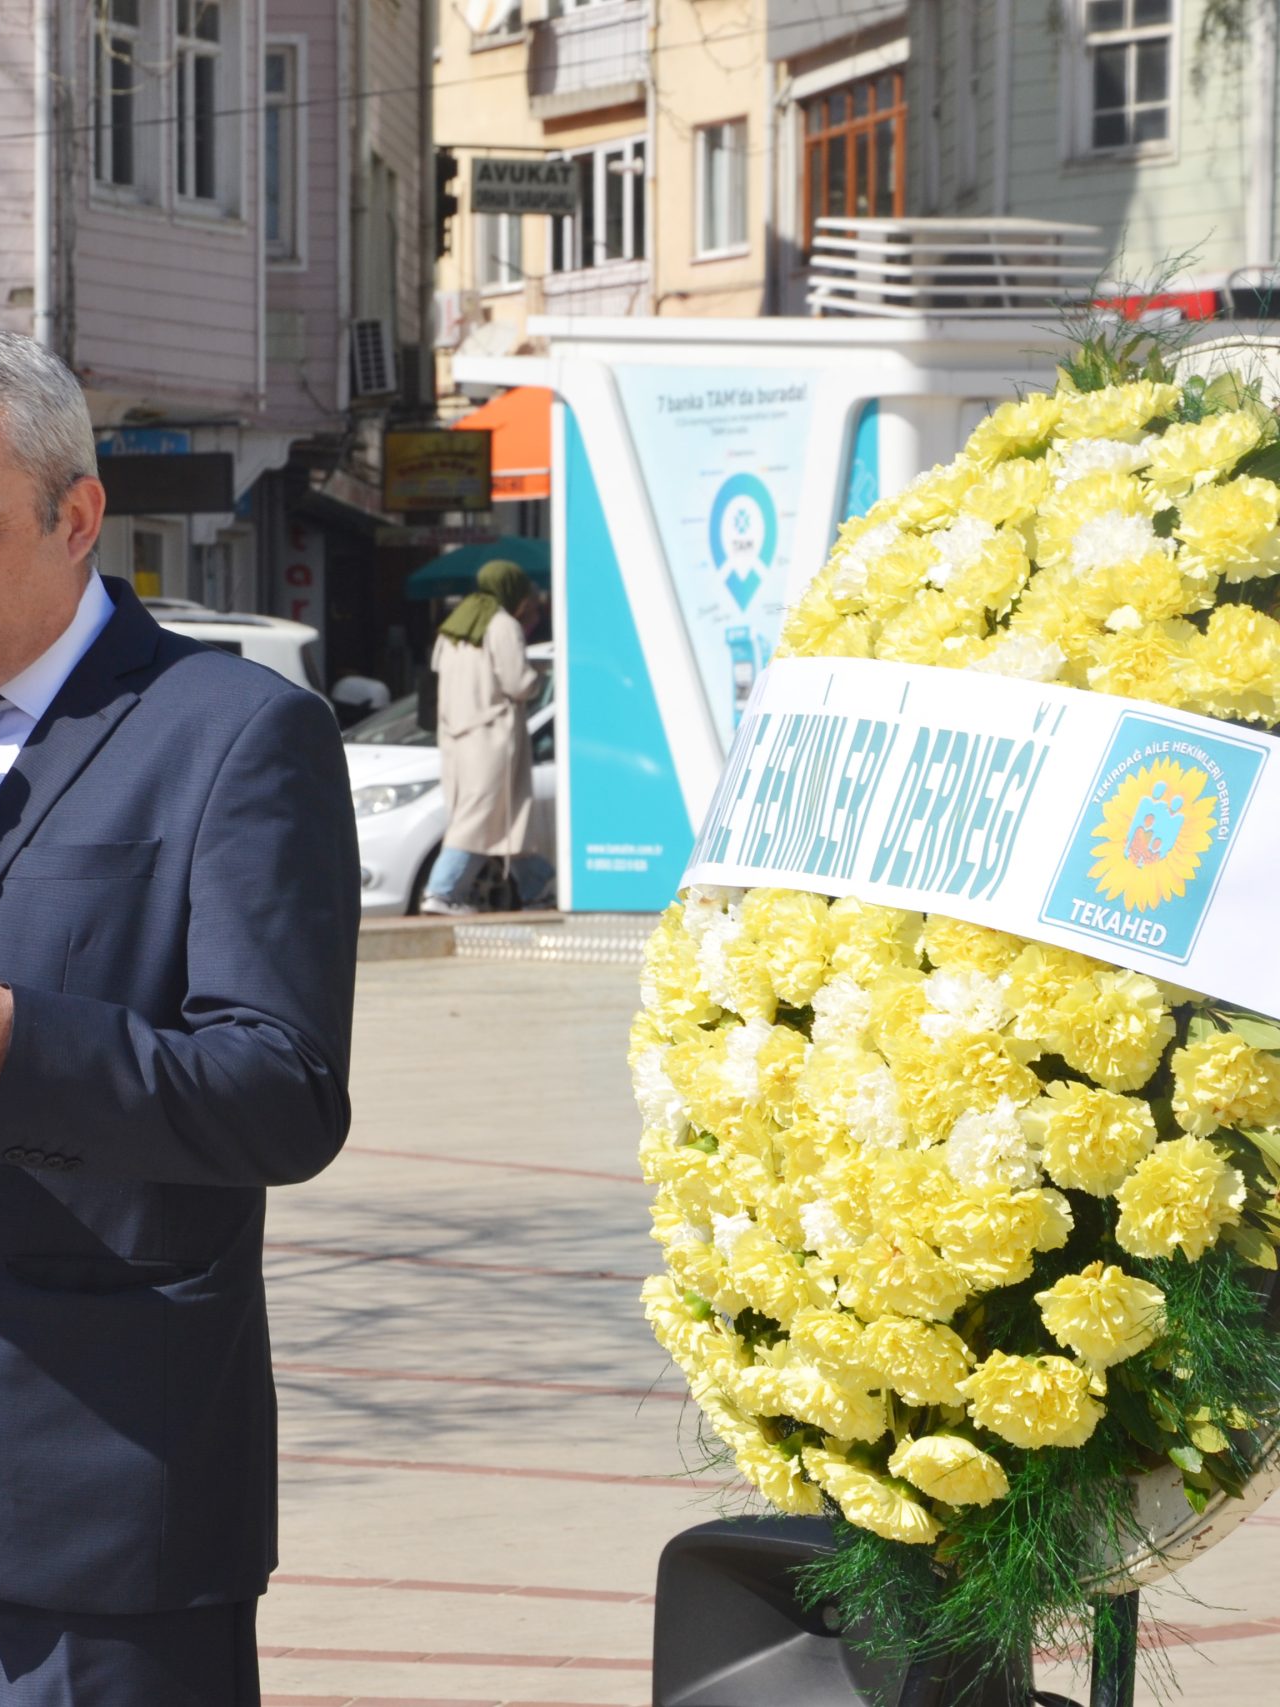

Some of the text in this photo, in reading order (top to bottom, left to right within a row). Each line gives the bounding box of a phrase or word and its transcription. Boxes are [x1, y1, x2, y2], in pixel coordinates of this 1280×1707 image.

[478, 164, 573, 184] AVUKAT
[869, 701, 1068, 902] DERNEĞİ
[1092, 740, 1231, 841] TEKİRDAĞ AİLE HEKİMLERİ DERNEĞİ
[1070, 898, 1168, 947] TEKAHED
